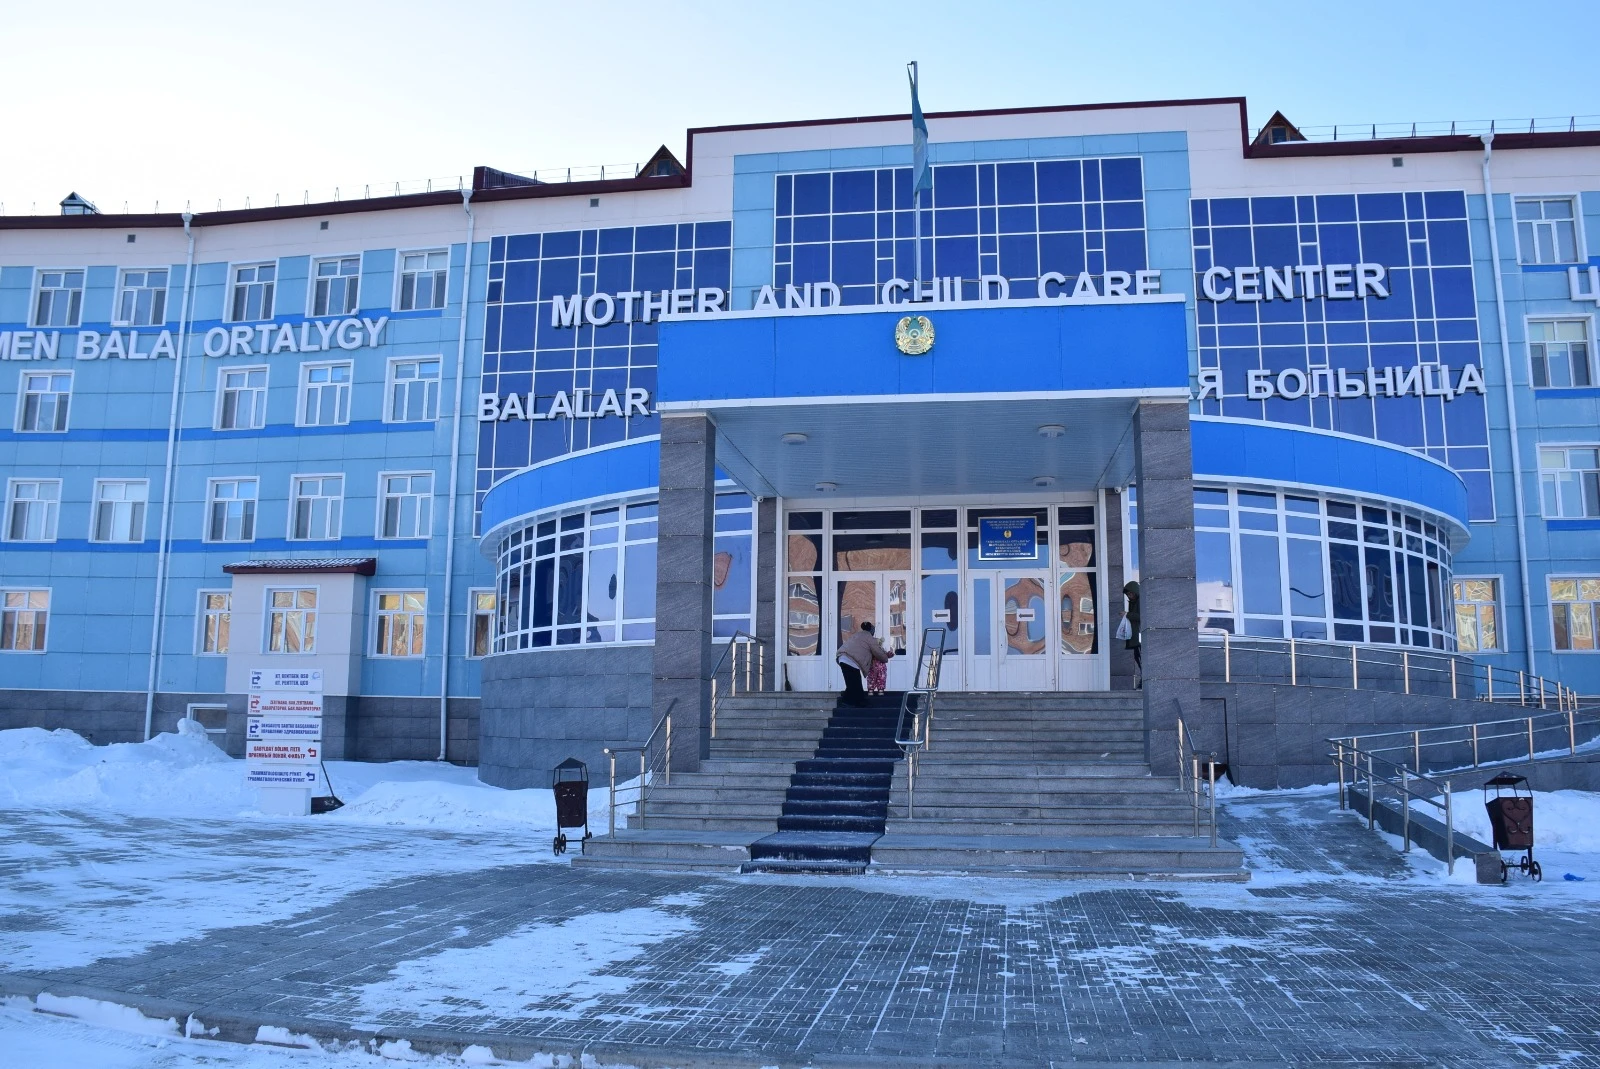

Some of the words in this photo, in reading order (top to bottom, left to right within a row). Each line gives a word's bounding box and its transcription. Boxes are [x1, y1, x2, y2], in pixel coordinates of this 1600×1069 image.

[551, 287, 727, 328] MOTHER
[753, 282, 841, 311] AND
[882, 275, 1009, 305] CHILD
[1037, 270, 1161, 300] CARE
[1202, 263, 1390, 301] CENTER
[76, 330, 176, 360] BALA
[1247, 364, 1487, 402] БОЛЬНИЦА
[478, 388, 649, 421] BALALAR
